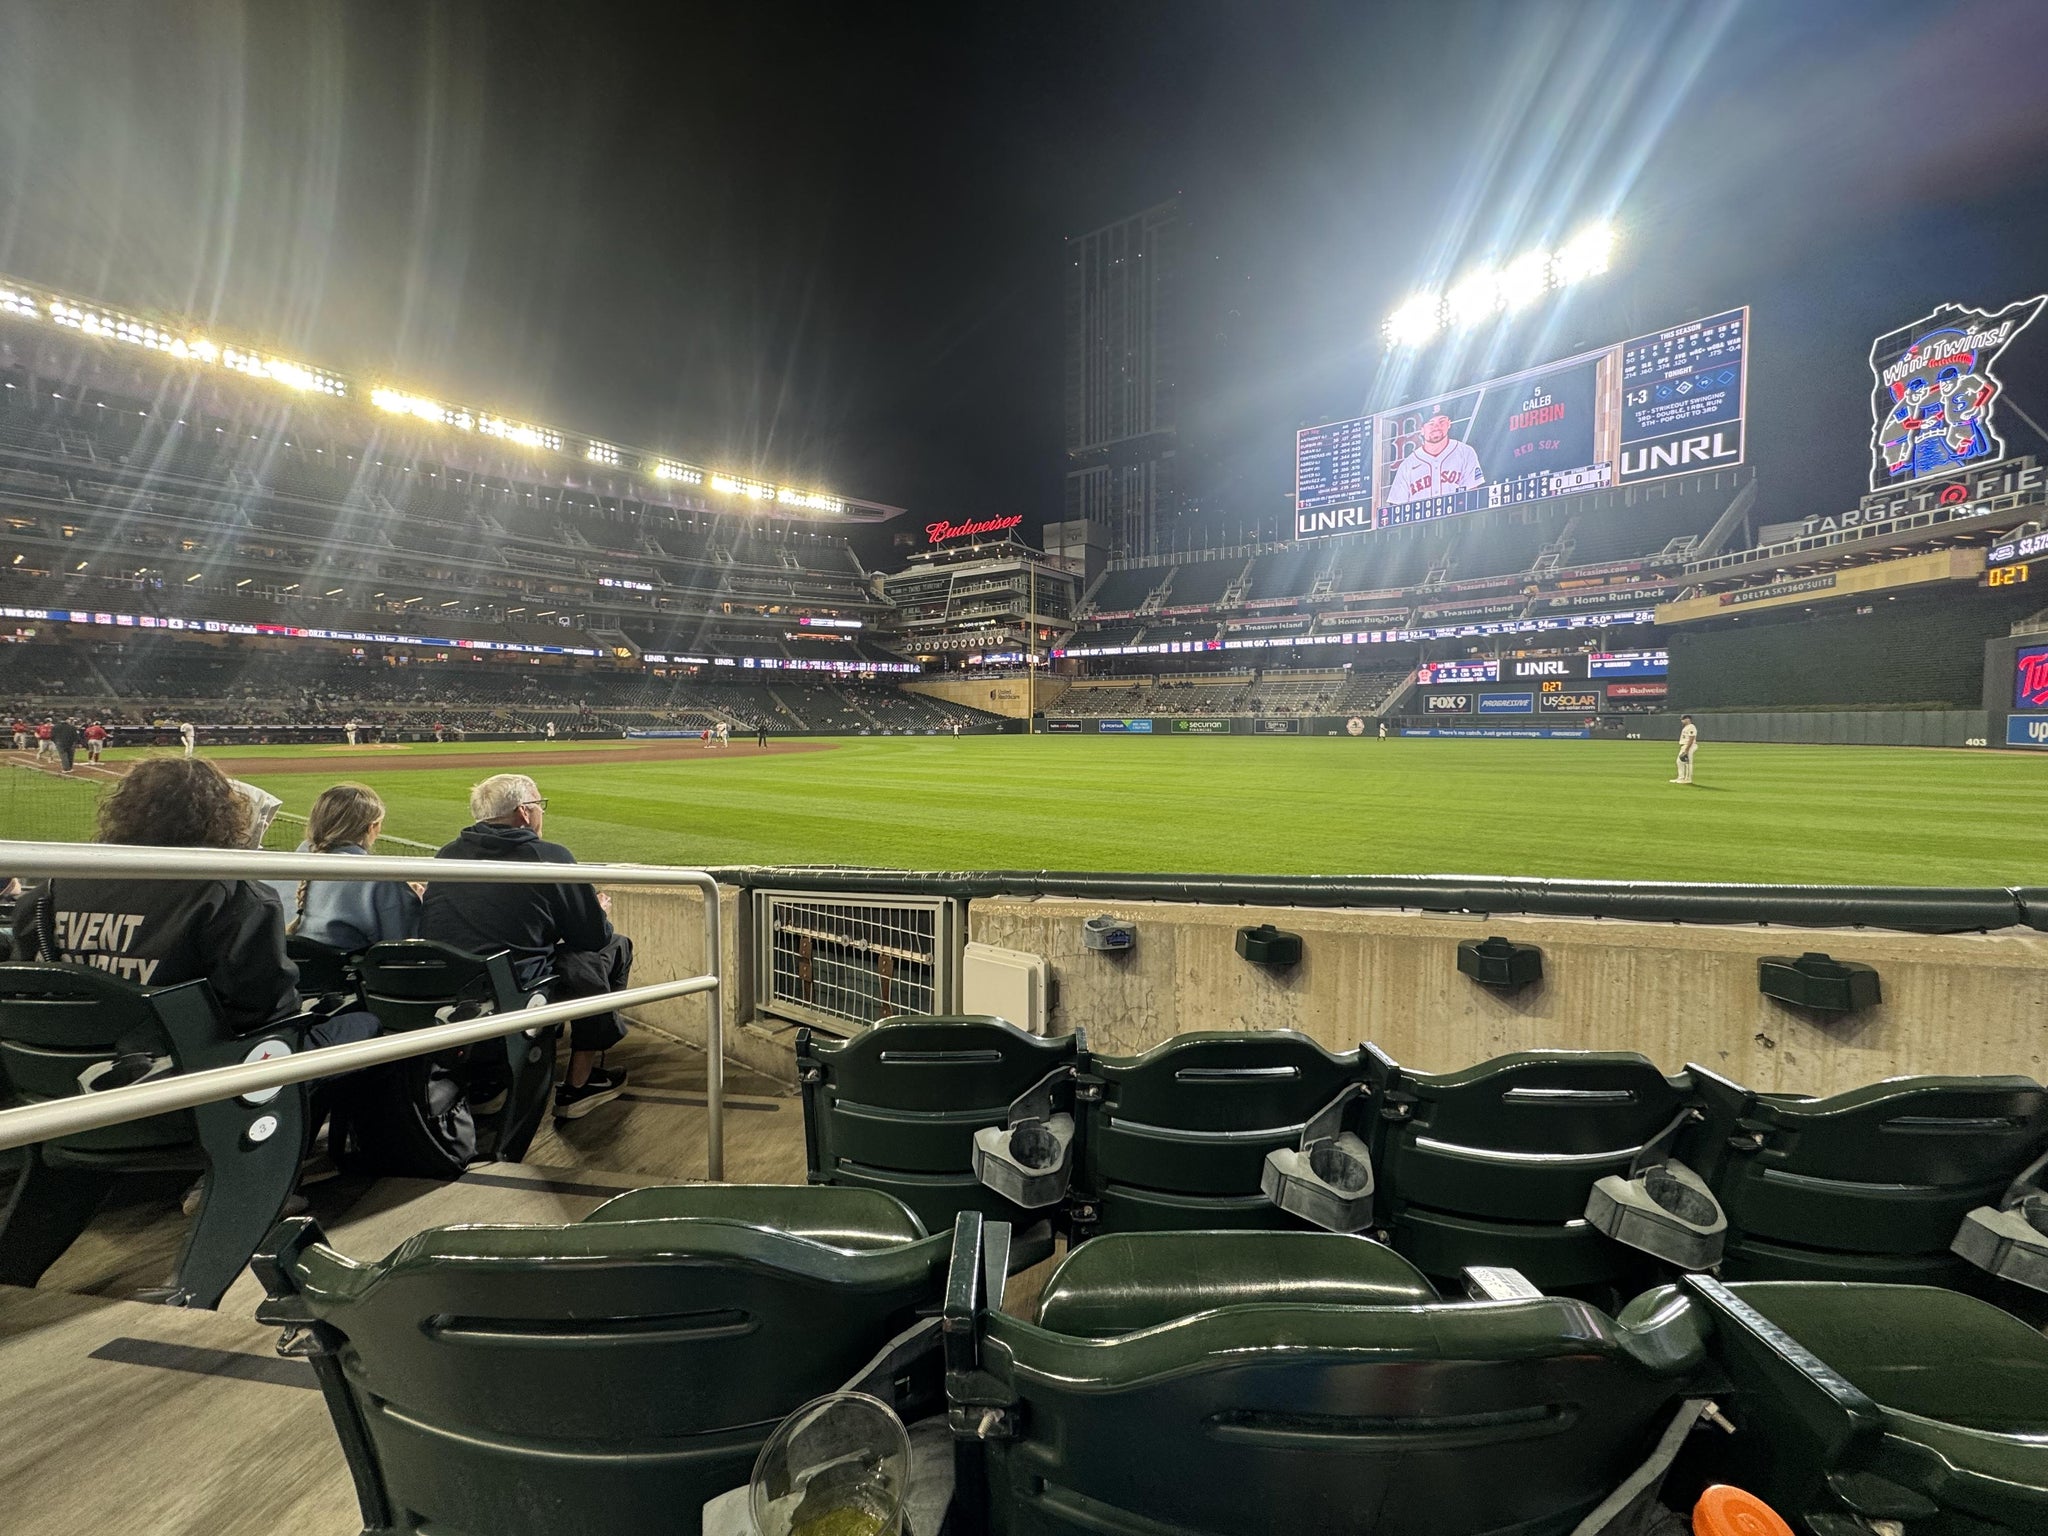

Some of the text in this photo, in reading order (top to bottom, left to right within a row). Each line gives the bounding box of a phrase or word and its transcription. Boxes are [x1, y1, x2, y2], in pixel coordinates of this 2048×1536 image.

[1660, 323, 1701, 340] THIS SEASON
[1932, 322, 2010, 360] Twins!
[1664, 366, 1693, 379] TONIGHT
[1535, 387, 1541, 396] 5
[1626, 389, 1648, 407] 1-3
[1522, 395, 1552, 411] CALEB
[1651, 400, 1689, 414] STRIKEOUT
[1690, 391, 1726, 404] SWINGING
[1509, 403, 1565, 431] DURBIN
[1660, 415, 1674, 424] POP
[1675, 412, 1690, 420] OUT
[1513, 440, 1560, 458] RED SOX
[1621, 432, 1737, 475] UNRL
[1410, 475, 1432, 496] RED
[1556, 478, 1562, 487] 0
[1576, 475, 1582, 484] 0
[1395, 506, 1400, 514] 0
[1405, 504, 1410, 512] 0
[1415, 502, 1421, 510] 3
[1426, 500, 1431, 508] 0
[1436, 498, 1441, 506] 0
[1529, 480, 1535, 488] 4
[1542, 477, 1547, 485] 2
[1447, 506, 1452, 514] 0
[1504, 495, 1510, 503] 11
[1516, 492, 1522, 501] 0
[1528, 490, 1535, 498] 4
[1541, 488, 1547, 496] 3
[1299, 507, 1371, 533] UNRL
[1803, 492, 1935, 534] TARGET
[925, 513, 1022, 543] Budweiser
[1988, 564, 2029, 587] 0:27
[1487, 580, 1508, 588] Island
[1742, 590, 1770, 600] DELTA
[1807, 578, 1833, 589] SUITE
[1573, 589, 1665, 605] Home Run Deck
[25, 610, 48, 619] GO!
[1485, 604, 1514, 613] Island
[1279, 621, 1303, 629] Island
[644, 655, 668, 663] UNRL
[714, 658, 736, 666] UNRL
[1515, 661, 1570, 675] UNRL
[1542, 681, 1562, 691] 0:27
[1428, 696, 1466, 709] FOX 9
[1481, 699, 1529, 707] PROGRESSIVE
[1965, 738, 1987, 746] 403
[54, 911, 145, 953] EVENT
